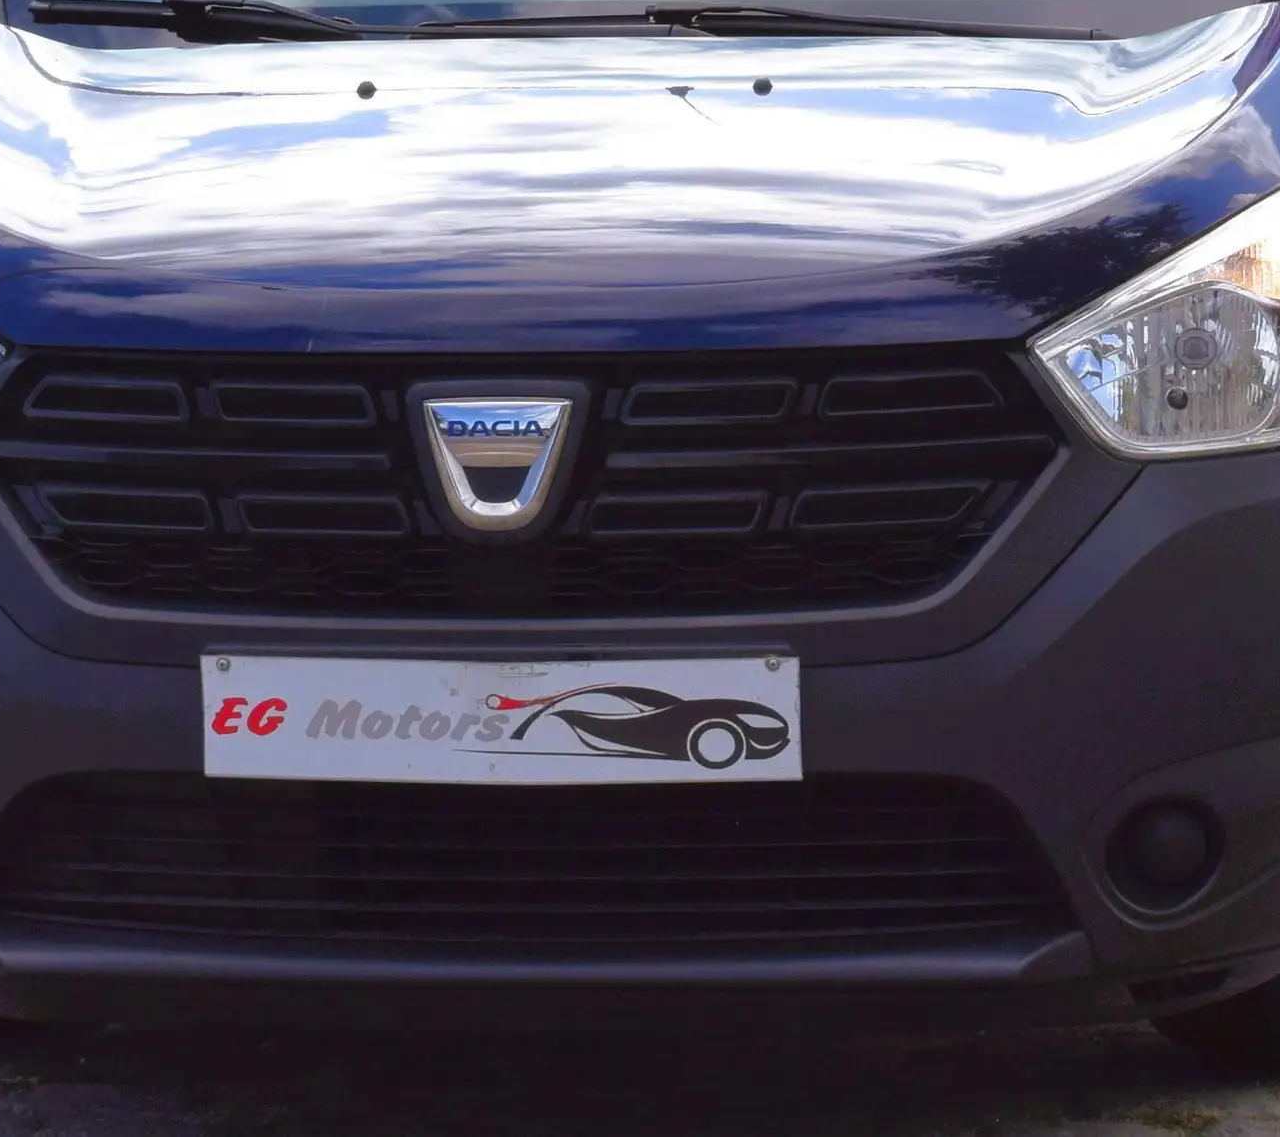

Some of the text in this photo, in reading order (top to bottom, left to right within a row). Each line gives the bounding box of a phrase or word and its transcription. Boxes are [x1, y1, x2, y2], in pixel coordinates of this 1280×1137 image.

[447, 420, 543, 437] DACIA
[211, 697, 511, 742] EG Motors
